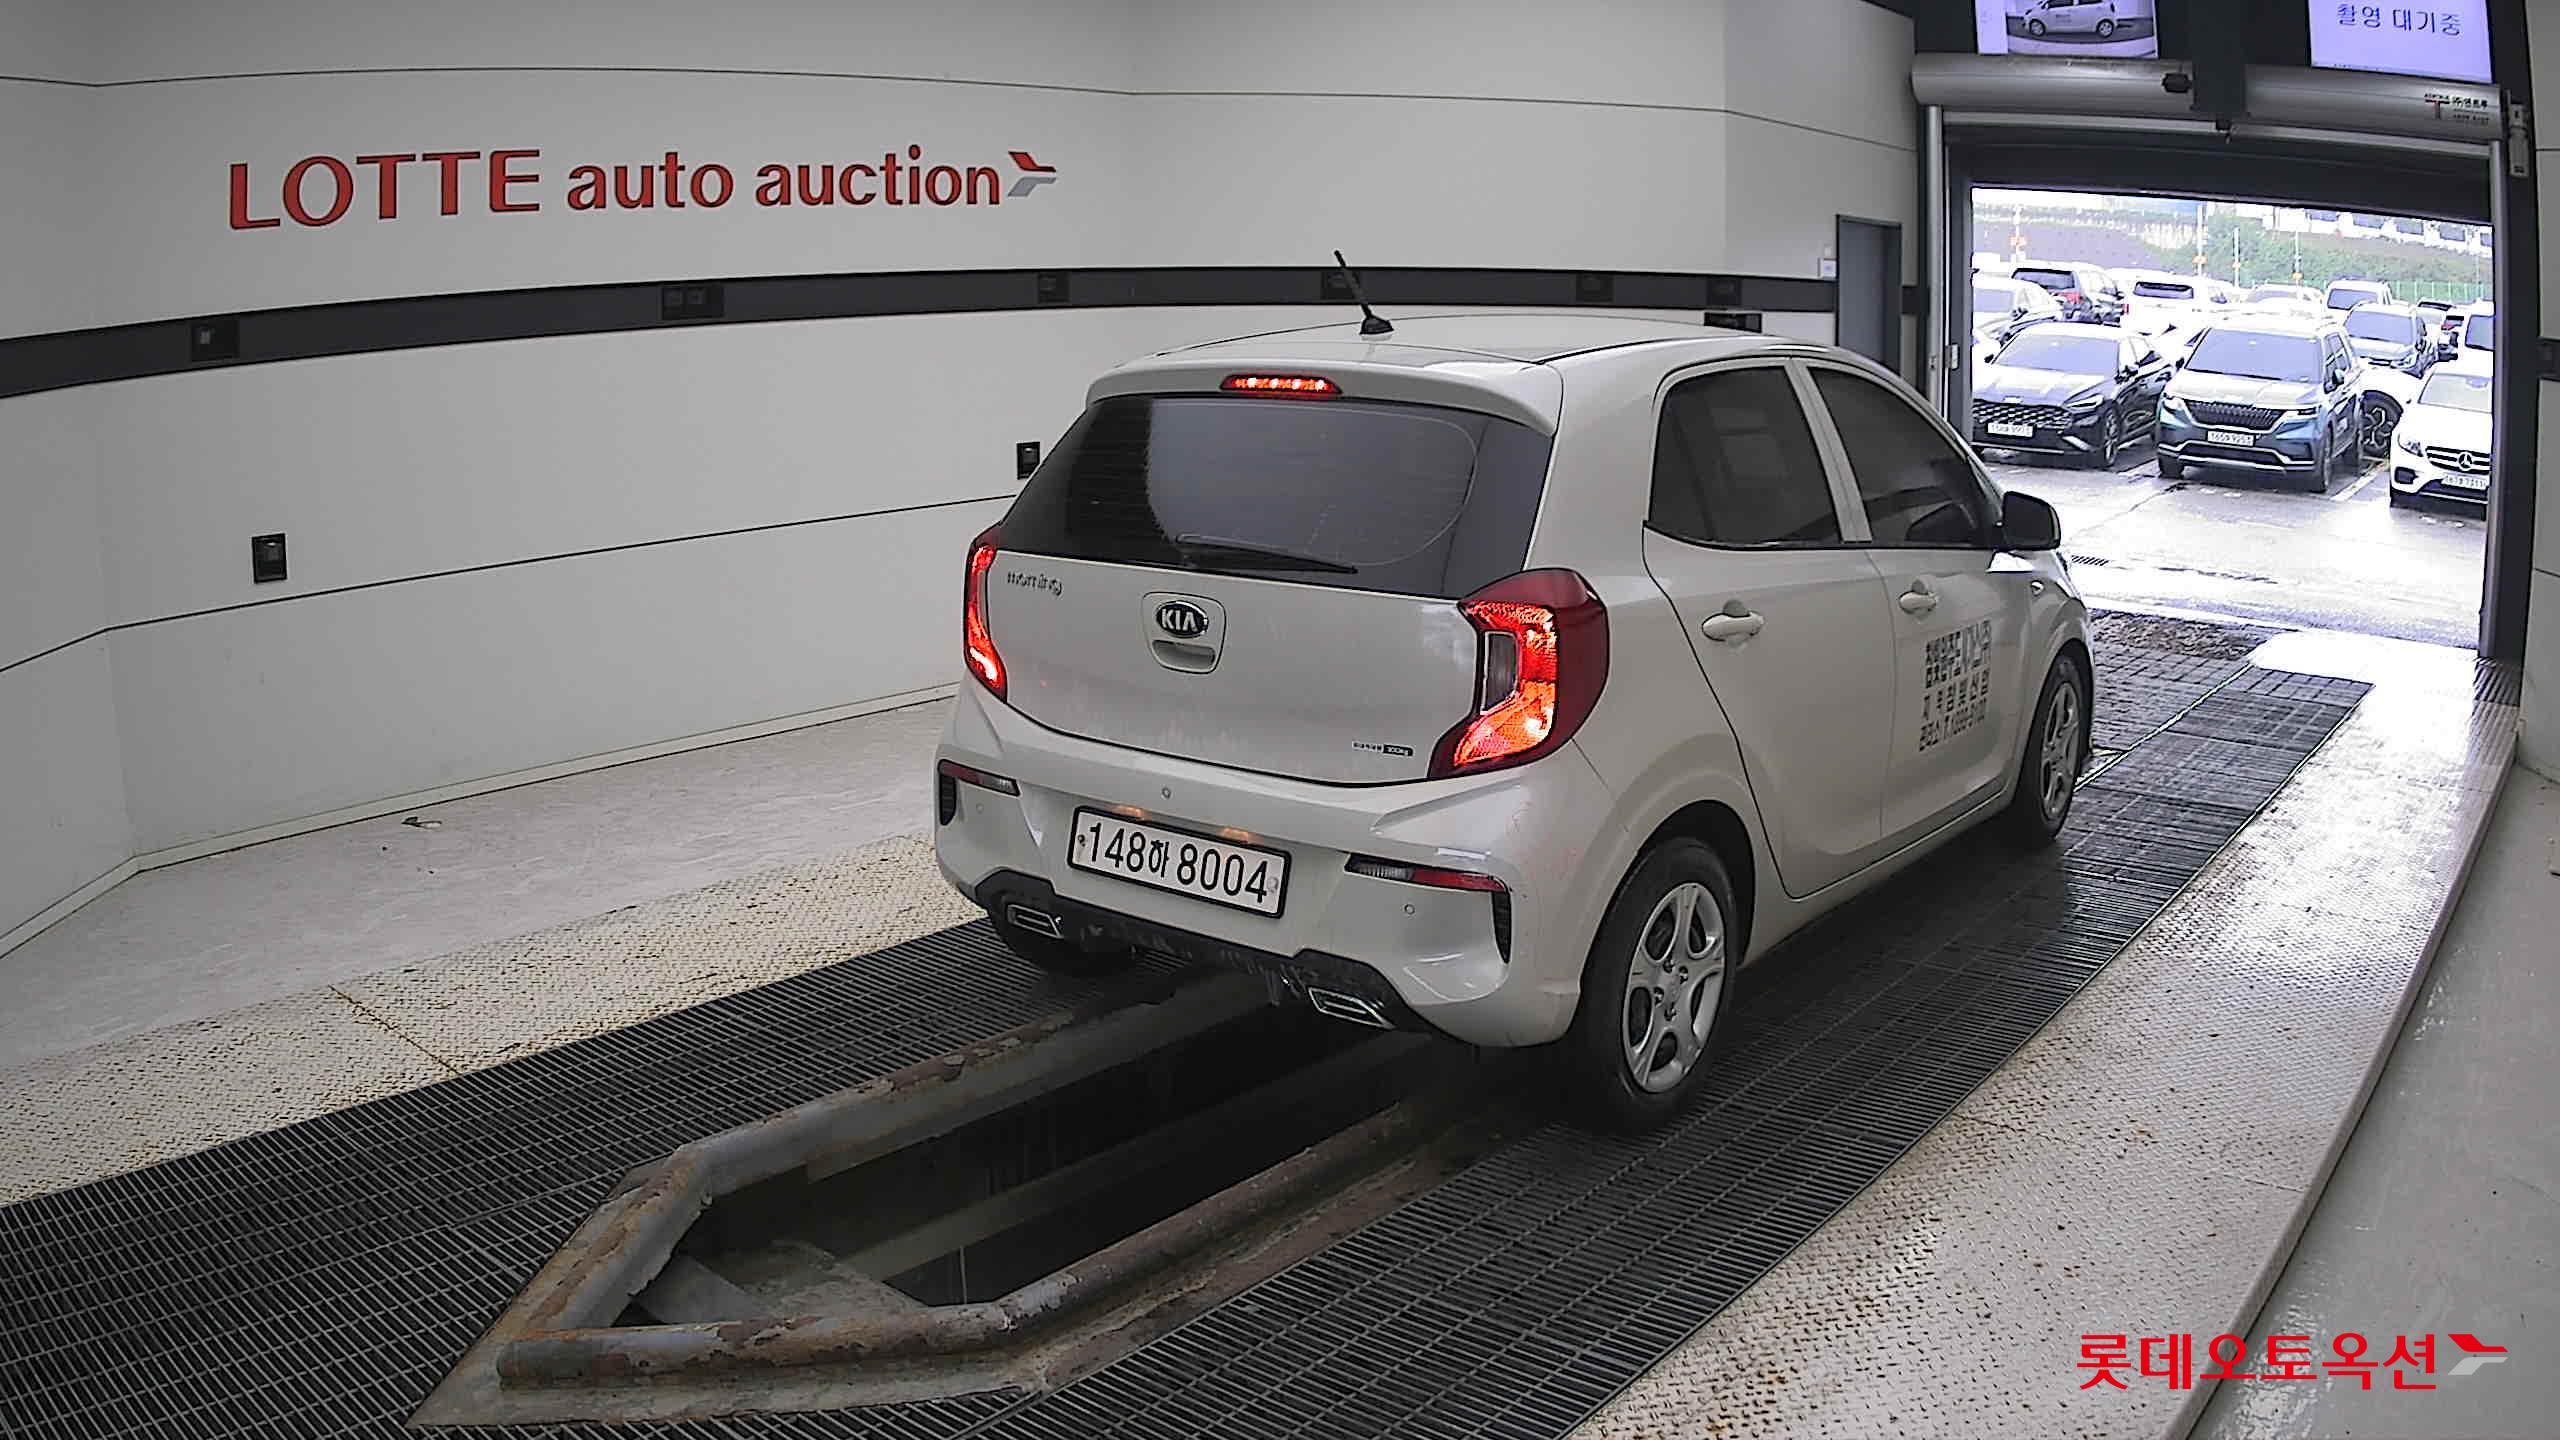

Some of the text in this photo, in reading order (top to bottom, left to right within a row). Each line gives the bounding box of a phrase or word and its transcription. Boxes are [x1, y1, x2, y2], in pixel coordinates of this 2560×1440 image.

[2338, 4, 2460, 36] 촬영 대기중
[229, 145, 1000, 230] LOTTE auto auction
[1161, 608, 1198, 632] KIA
[1089, 822, 1268, 904] 148하 8004
